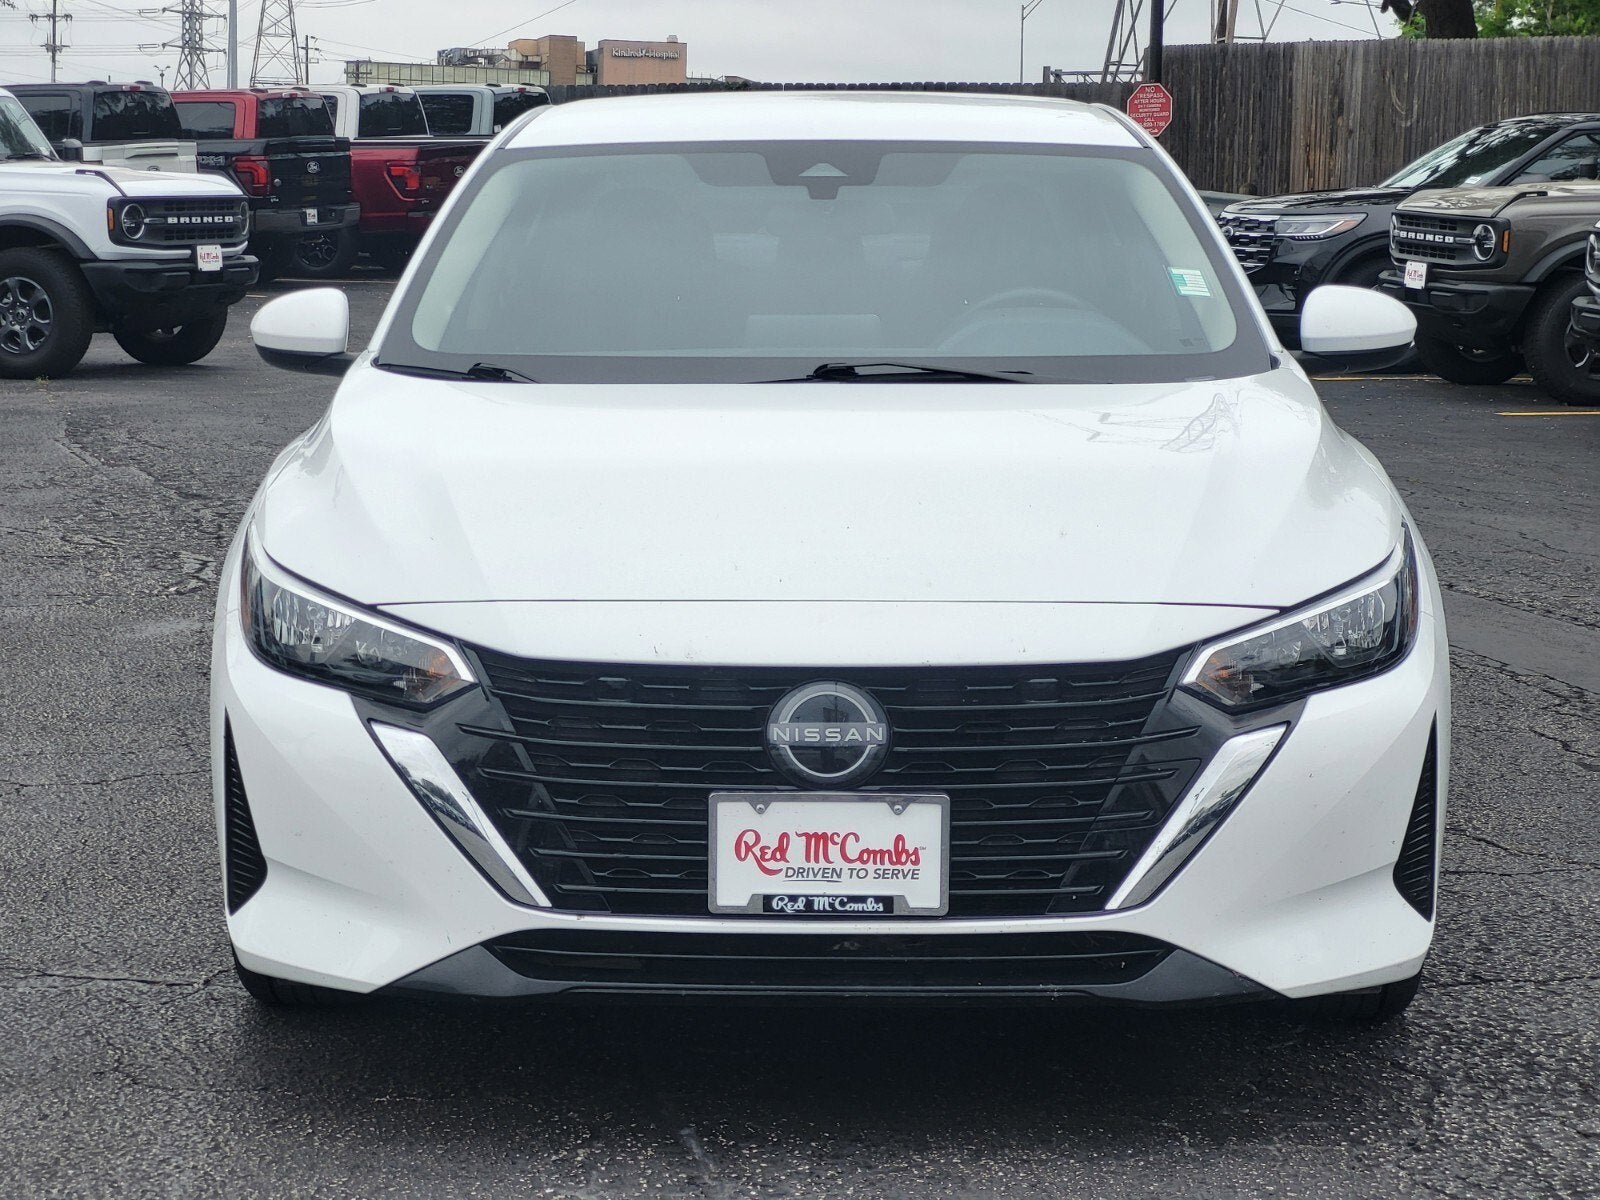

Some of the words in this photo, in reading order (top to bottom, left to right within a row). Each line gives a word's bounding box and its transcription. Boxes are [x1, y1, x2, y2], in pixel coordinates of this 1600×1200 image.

[649, 49, 680, 60] Hospital
[167, 215, 234, 224] BRONCO
[1400, 230, 1454, 244] BRONCO
[773, 727, 883, 742] NISSAN
[734, 828, 791, 876] Red
[795, 831, 921, 867] McCombs
[784, 866, 843, 879] DRIVEN
[848, 867, 869, 880] TO
[873, 868, 921, 880] SERVE
[772, 895, 806, 913] Red
[808, 895, 884, 912] McCombs
